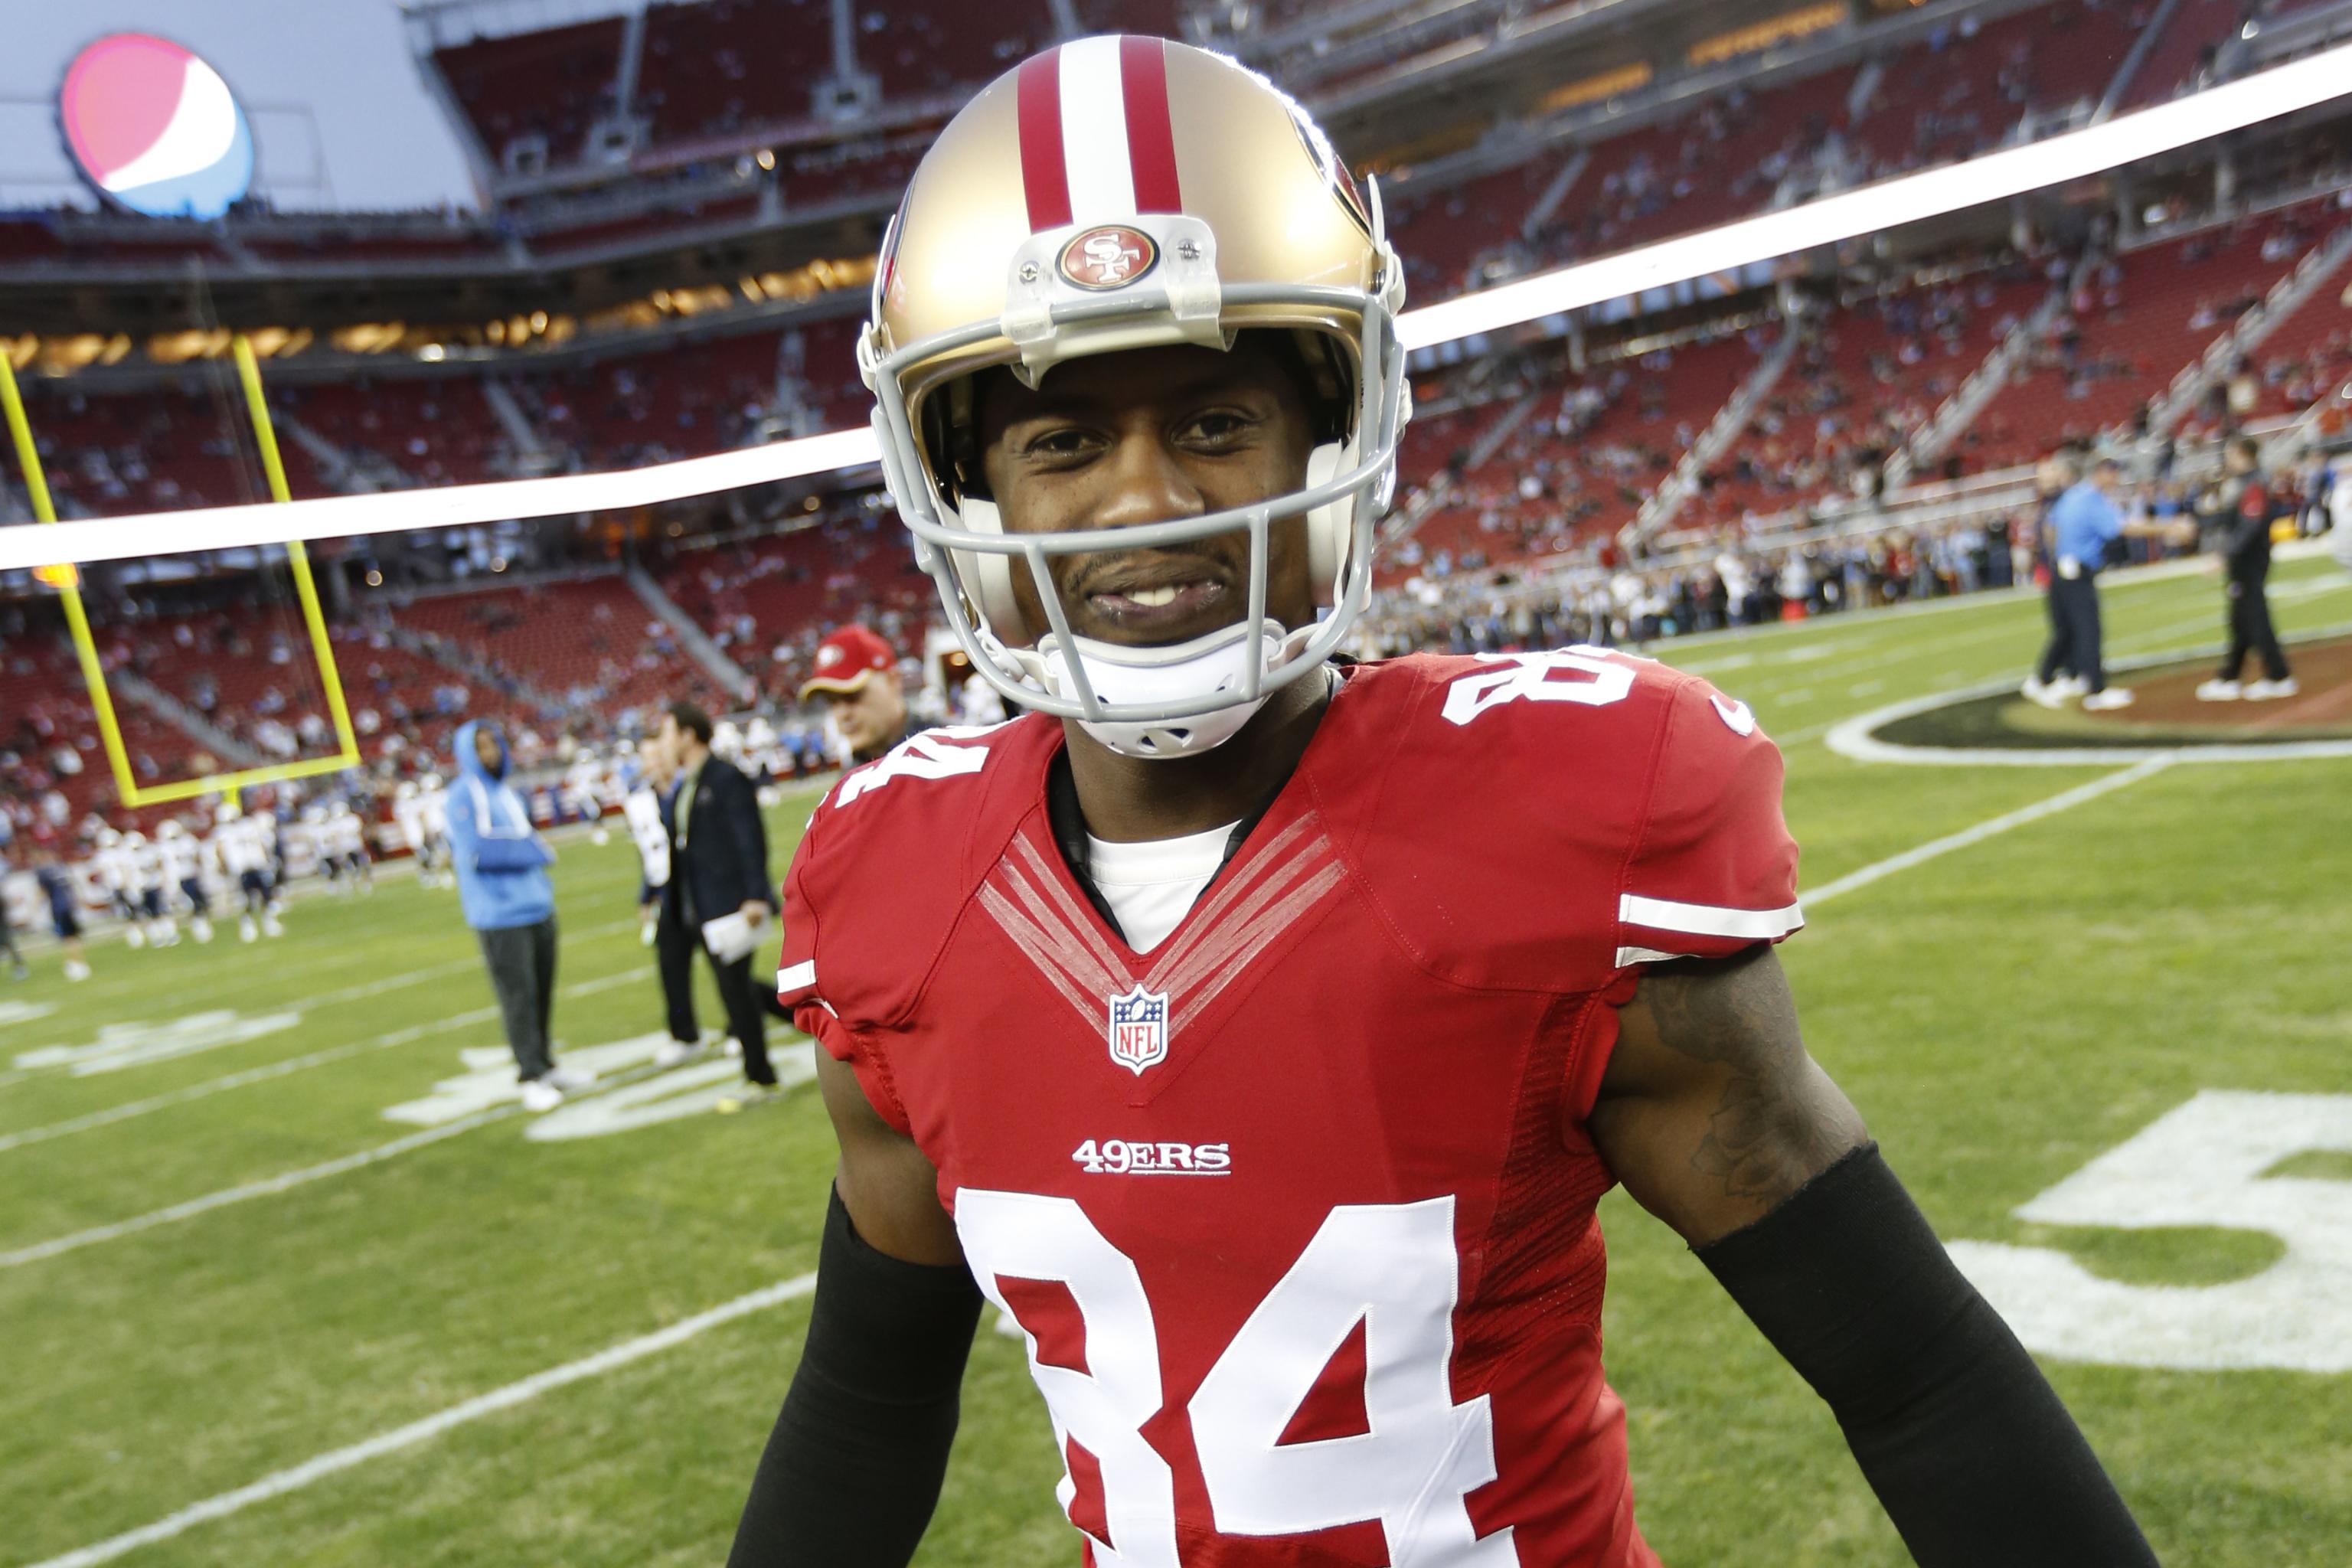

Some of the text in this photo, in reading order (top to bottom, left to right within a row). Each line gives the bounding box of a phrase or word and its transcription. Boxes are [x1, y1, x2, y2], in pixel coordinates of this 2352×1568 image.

[1084, 233, 1141, 283] SF
[1119, 1025, 1158, 1058] NFL
[1072, 1139, 1232, 1175] 49ERS
[955, 1187, 1521, 1568] 84
